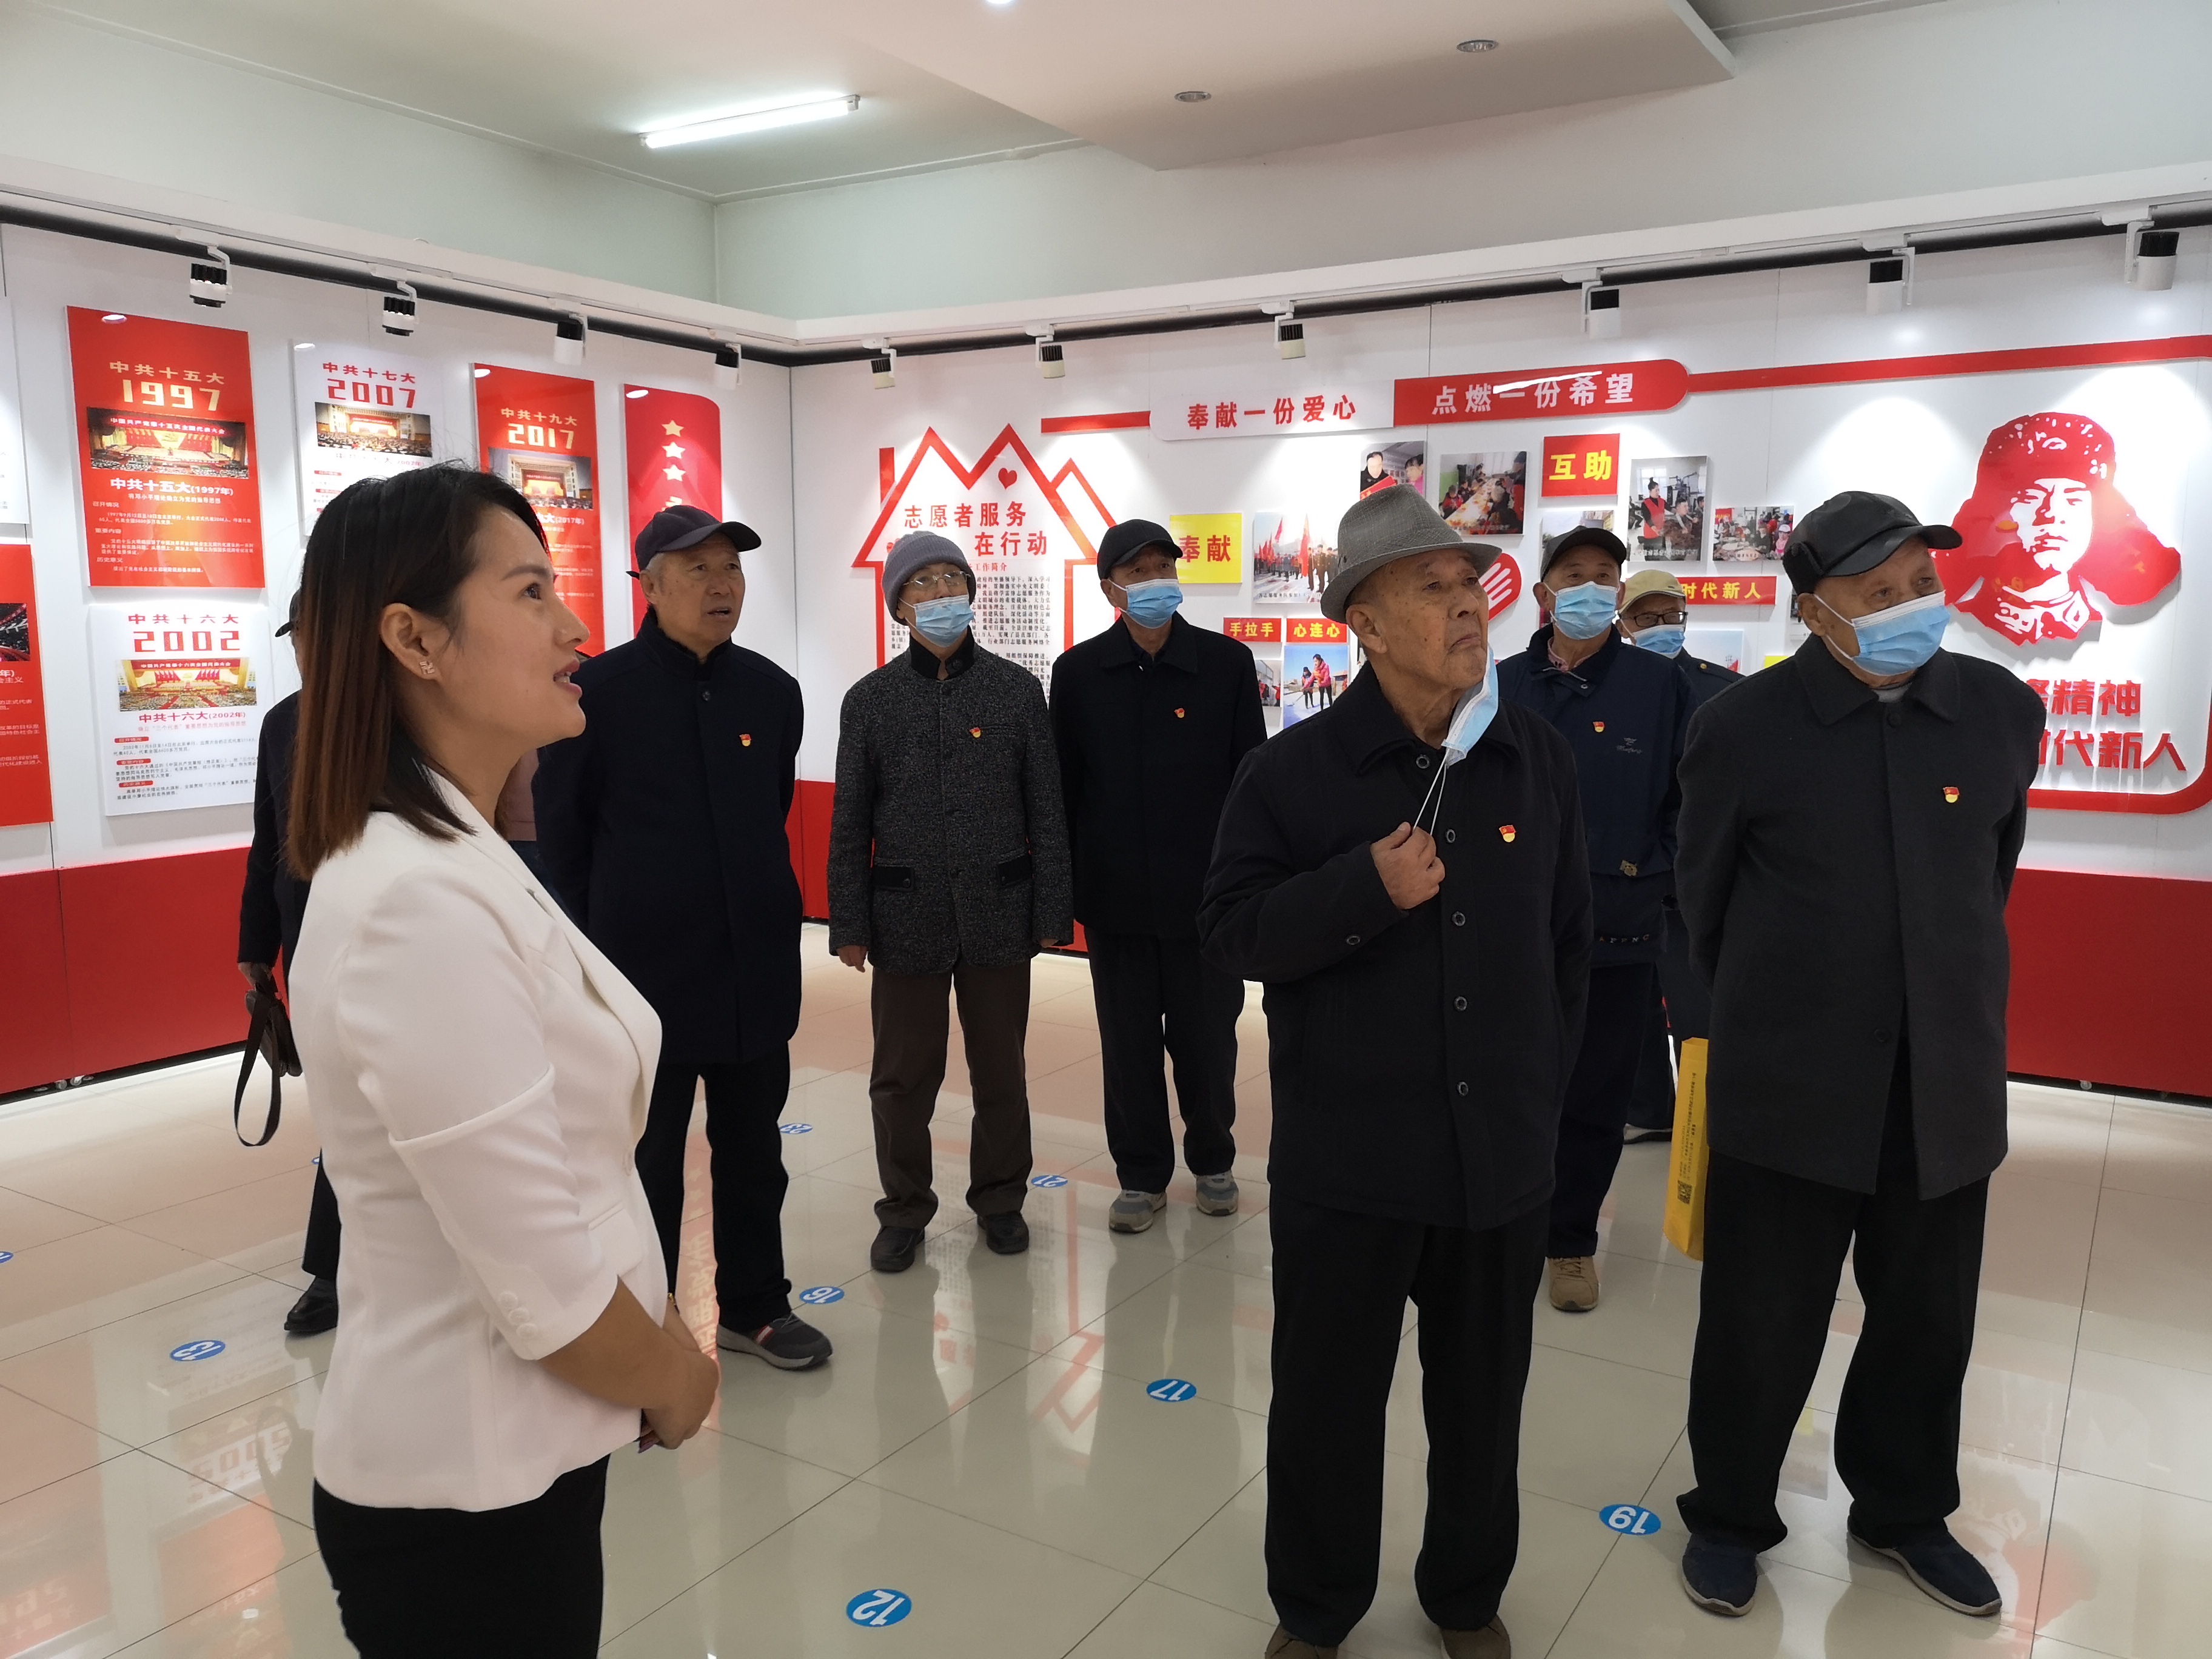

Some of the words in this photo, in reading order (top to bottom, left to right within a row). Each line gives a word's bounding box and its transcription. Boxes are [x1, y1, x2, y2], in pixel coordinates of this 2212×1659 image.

[110, 361, 225, 385] 中共十五大
[323, 362, 416, 384] 中共十七大
[122, 379, 221, 411] 1997
[327, 378, 415, 408] 2007
[1432, 372, 1635, 415] 点燃一份希望
[501, 407, 577, 426] 中共十九大
[1187, 394, 1357, 431] 奉献一份爱心
[508, 423, 574, 449] 2017
[1549, 450, 1612, 481] 互助
[110, 477, 234, 496] 中共十五大(1997年)
[904, 501, 1027, 528] 志愿者服务
[974, 531, 1047, 556] 在行动
[1177, 535, 1231, 563] 奉献
[1681, 581, 1761, 599] 时代新人
[128, 614, 239, 625] 中共十六大
[1229, 622, 1274, 637] 手拉手
[1293, 622, 1341, 638] 心连心
[133, 631, 240, 652] 2002
[139, 711, 246, 723] 中共十六大(2002年)
[1033, 1175, 1068, 1187] 21
[802, 1287, 842, 1304] 16
[173, 1341, 221, 1361] 13
[1150, 1380, 1191, 1401] 17
[1608, 1506, 1650, 1534] 19
[852, 1589, 906, 1626] 12
